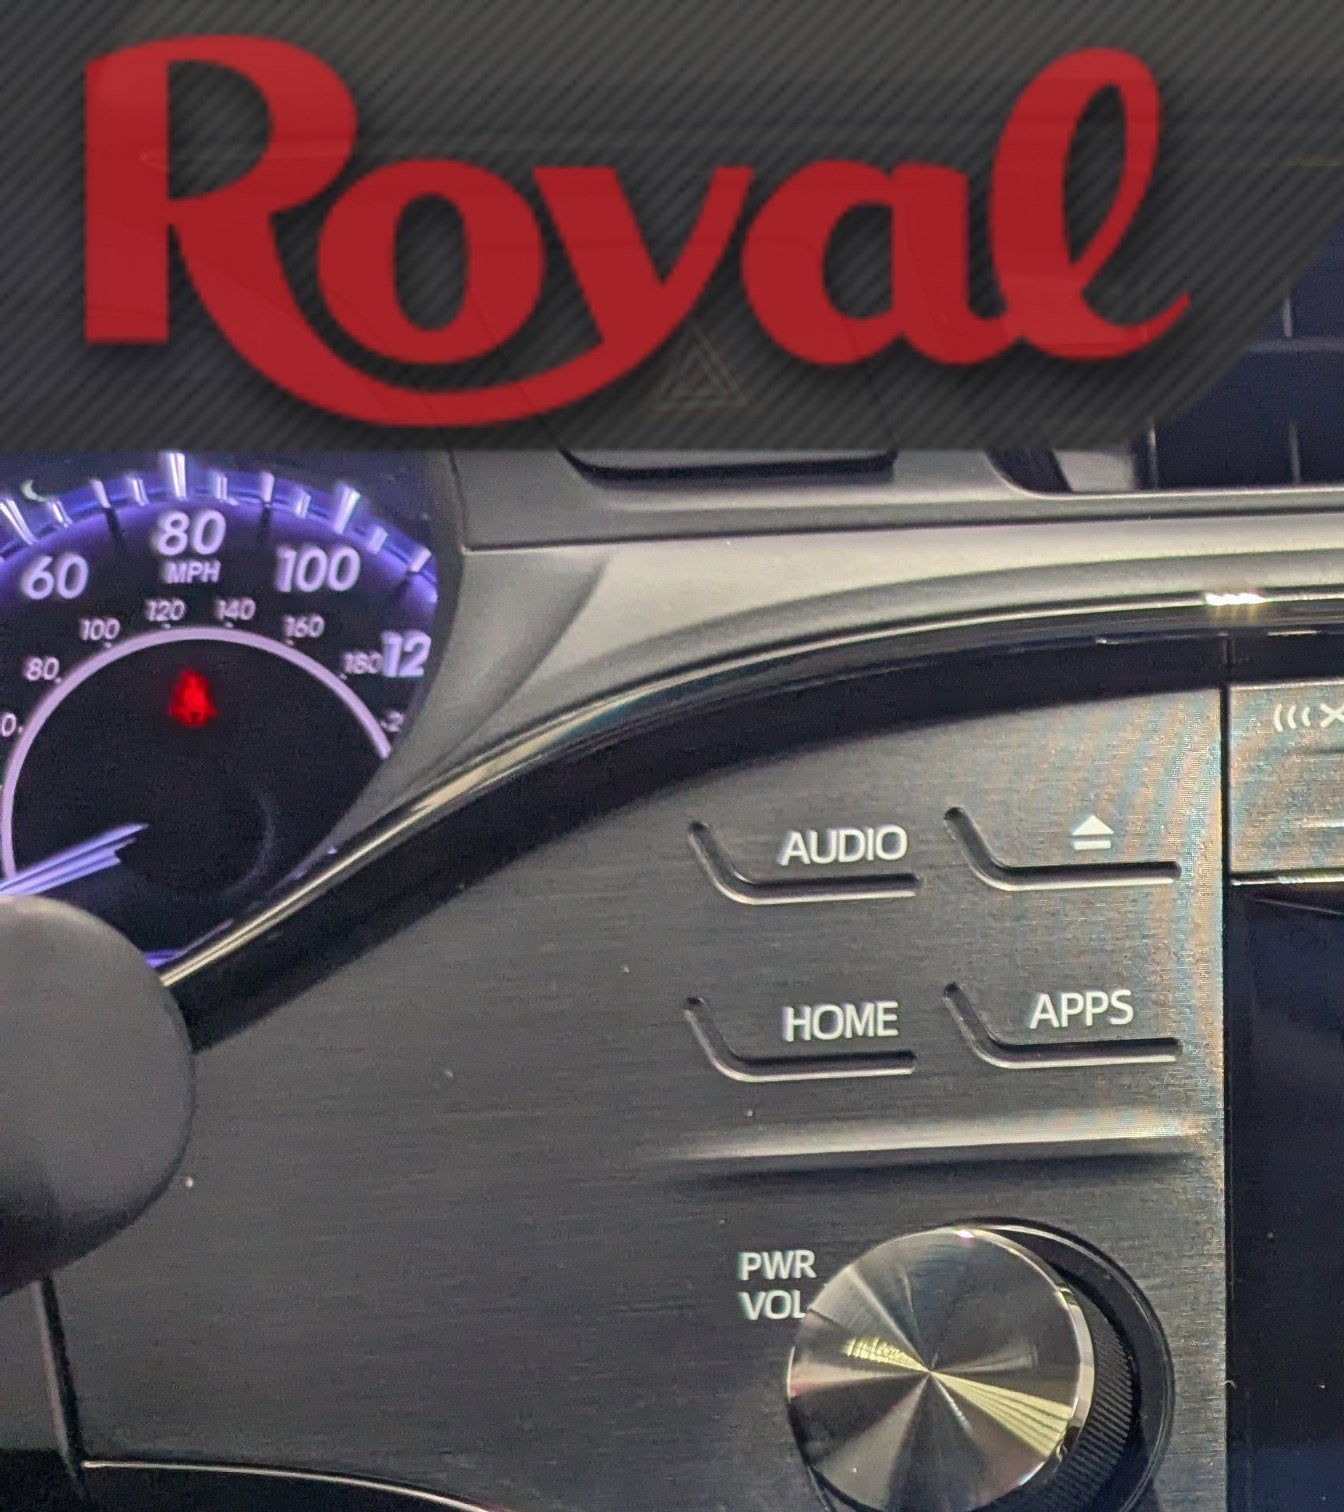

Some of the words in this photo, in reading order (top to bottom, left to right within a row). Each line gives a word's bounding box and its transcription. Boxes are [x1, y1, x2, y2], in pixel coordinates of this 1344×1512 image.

[152, 509, 226, 556] 80
[21, 555, 88, 600] 60
[162, 560, 222, 585] MPH
[276, 546, 361, 594] 100
[145, 599, 186, 622] 120
[215, 598, 256, 622] 140
[79, 617, 122, 641] 100
[283, 615, 326, 638] 160
[23, 658, 60, 682] 80
[380, 630, 432, 678] 12
[779, 825, 908, 866] AUDIO
[782, 1002, 899, 1043] HOME
[1029, 989, 1134, 1030] APPS
[737, 1249, 817, 1281] PWR
[737, 1289, 807, 1321] VOL
